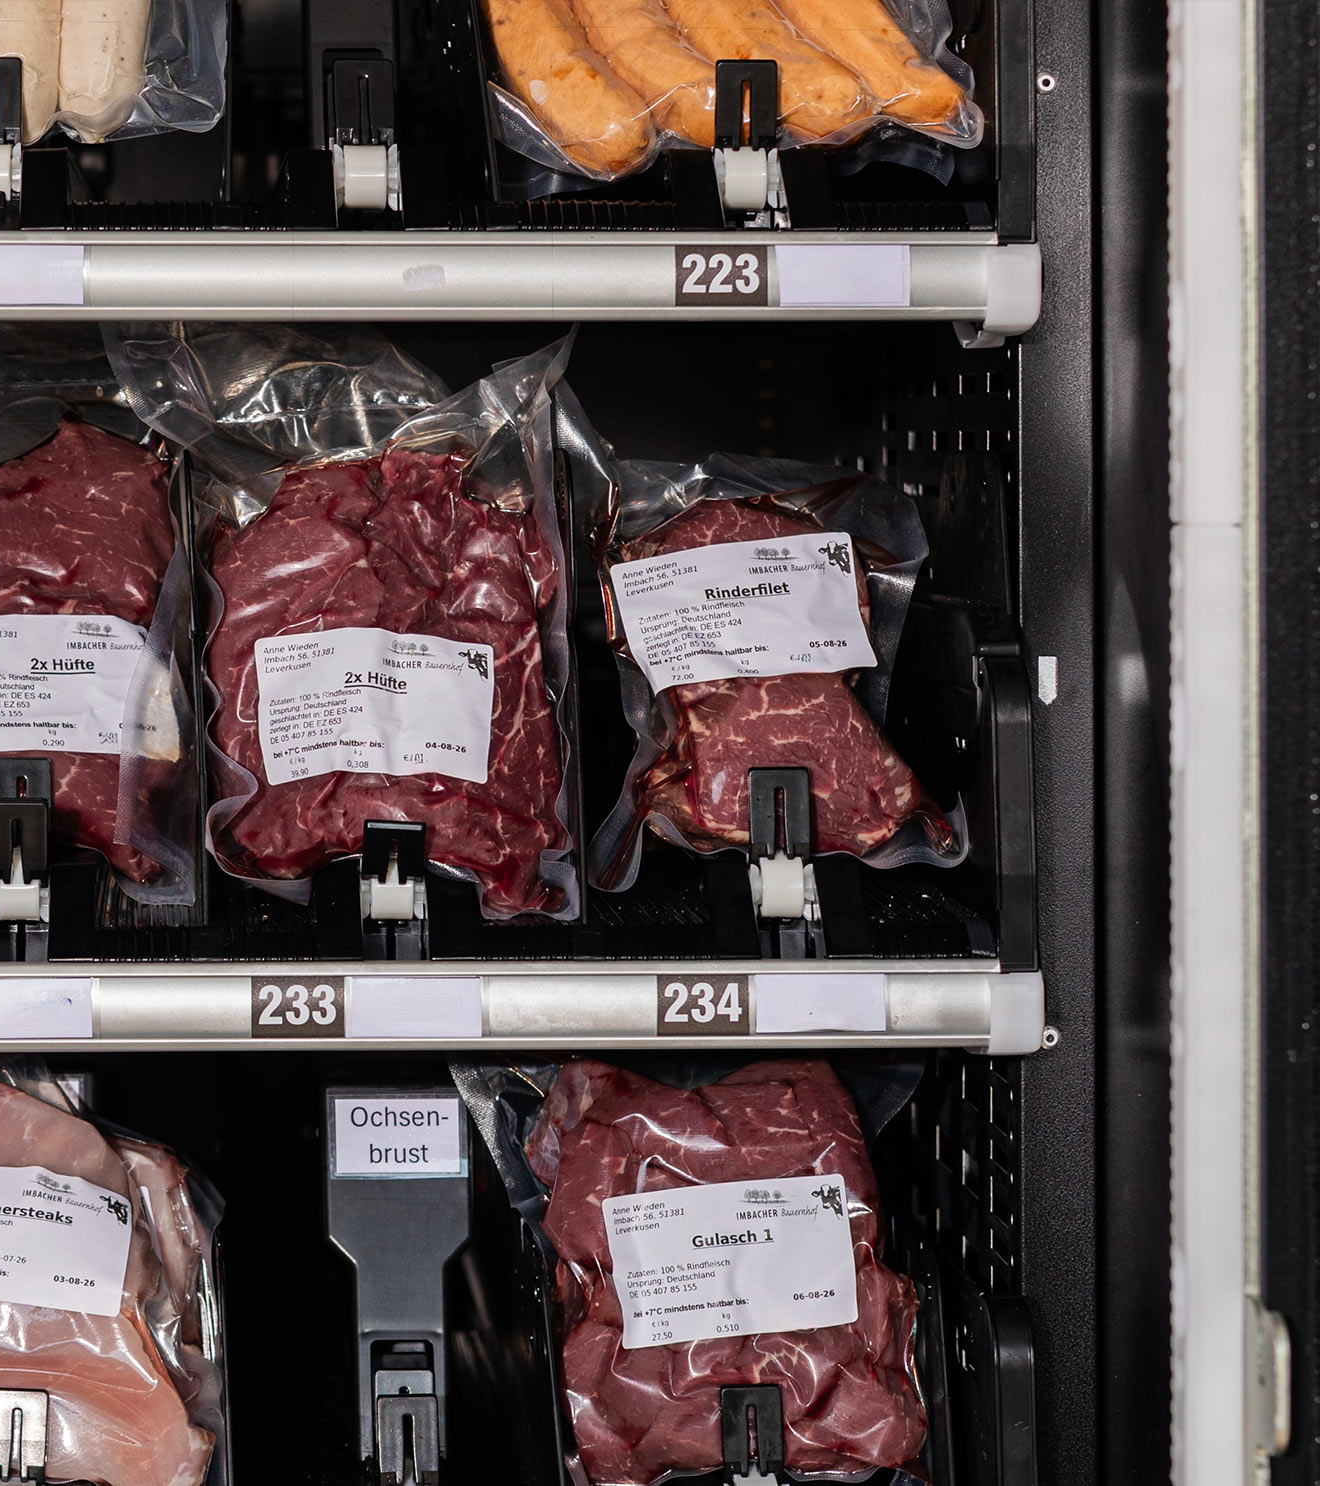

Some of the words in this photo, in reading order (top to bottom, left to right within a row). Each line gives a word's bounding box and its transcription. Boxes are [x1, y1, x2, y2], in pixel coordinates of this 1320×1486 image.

[683, 254, 759, 293] 223
[622, 568, 643, 580] Anne
[645, 561, 677, 575] Wieden
[624, 576, 655, 589] Imbach
[657, 574, 671, 584] 56,
[672, 565, 698, 577] 51381
[749, 565, 788, 575] IMBACHER
[626, 580, 674, 597] Leverkusen
[705, 582, 790, 600] Rinderfilet
[67, 642, 107, 650] IMBACHER
[264, 645, 285, 655] Anne
[288, 641, 319, 652] Wieden
[809, 640, 848, 648] 05-08-26
[264, 654, 295, 664] Imbach
[297, 652, 310, 661] 56,
[312, 648, 334, 658] 51381
[30, 658, 48, 671] 2x
[53, 657, 95, 671] Hüfte
[265, 661, 311, 674] Leverkusen
[383, 658, 422, 669] IMBACHER
[344, 672, 362, 684] 2x
[368, 672, 407, 690] Hüfte
[425, 742, 466, 753] 04-08-26
[259, 985, 336, 1025] 233
[665, 983, 742, 1022] 234
[351, 1107, 448, 1127] Ochsen-
[370, 1144, 428, 1163] brust
[22, 1189, 63, 1203] IMBACHER
[612, 1205, 630, 1215] Anne
[632, 1201, 665, 1212] Weden
[643, 1211, 656, 1221] 56,
[659, 1208, 685, 1218] 51381
[736, 1209, 778, 1220] IMBACHER
[615, 1221, 660, 1235] Leverkusen
[692, 1230, 757, 1248] Gulasch
[764, 1229, 774, 1241] 1
[661, 1265, 675, 1275] 100
[687, 1259, 730, 1271] Rindfleisch
[53, 1275, 95, 1287] 03-08-26
[627, 1277, 664, 1289] Ursprung:
[667, 1270, 715, 1283] Deutschland
[793, 1290, 835, 1301] 06-08-26
